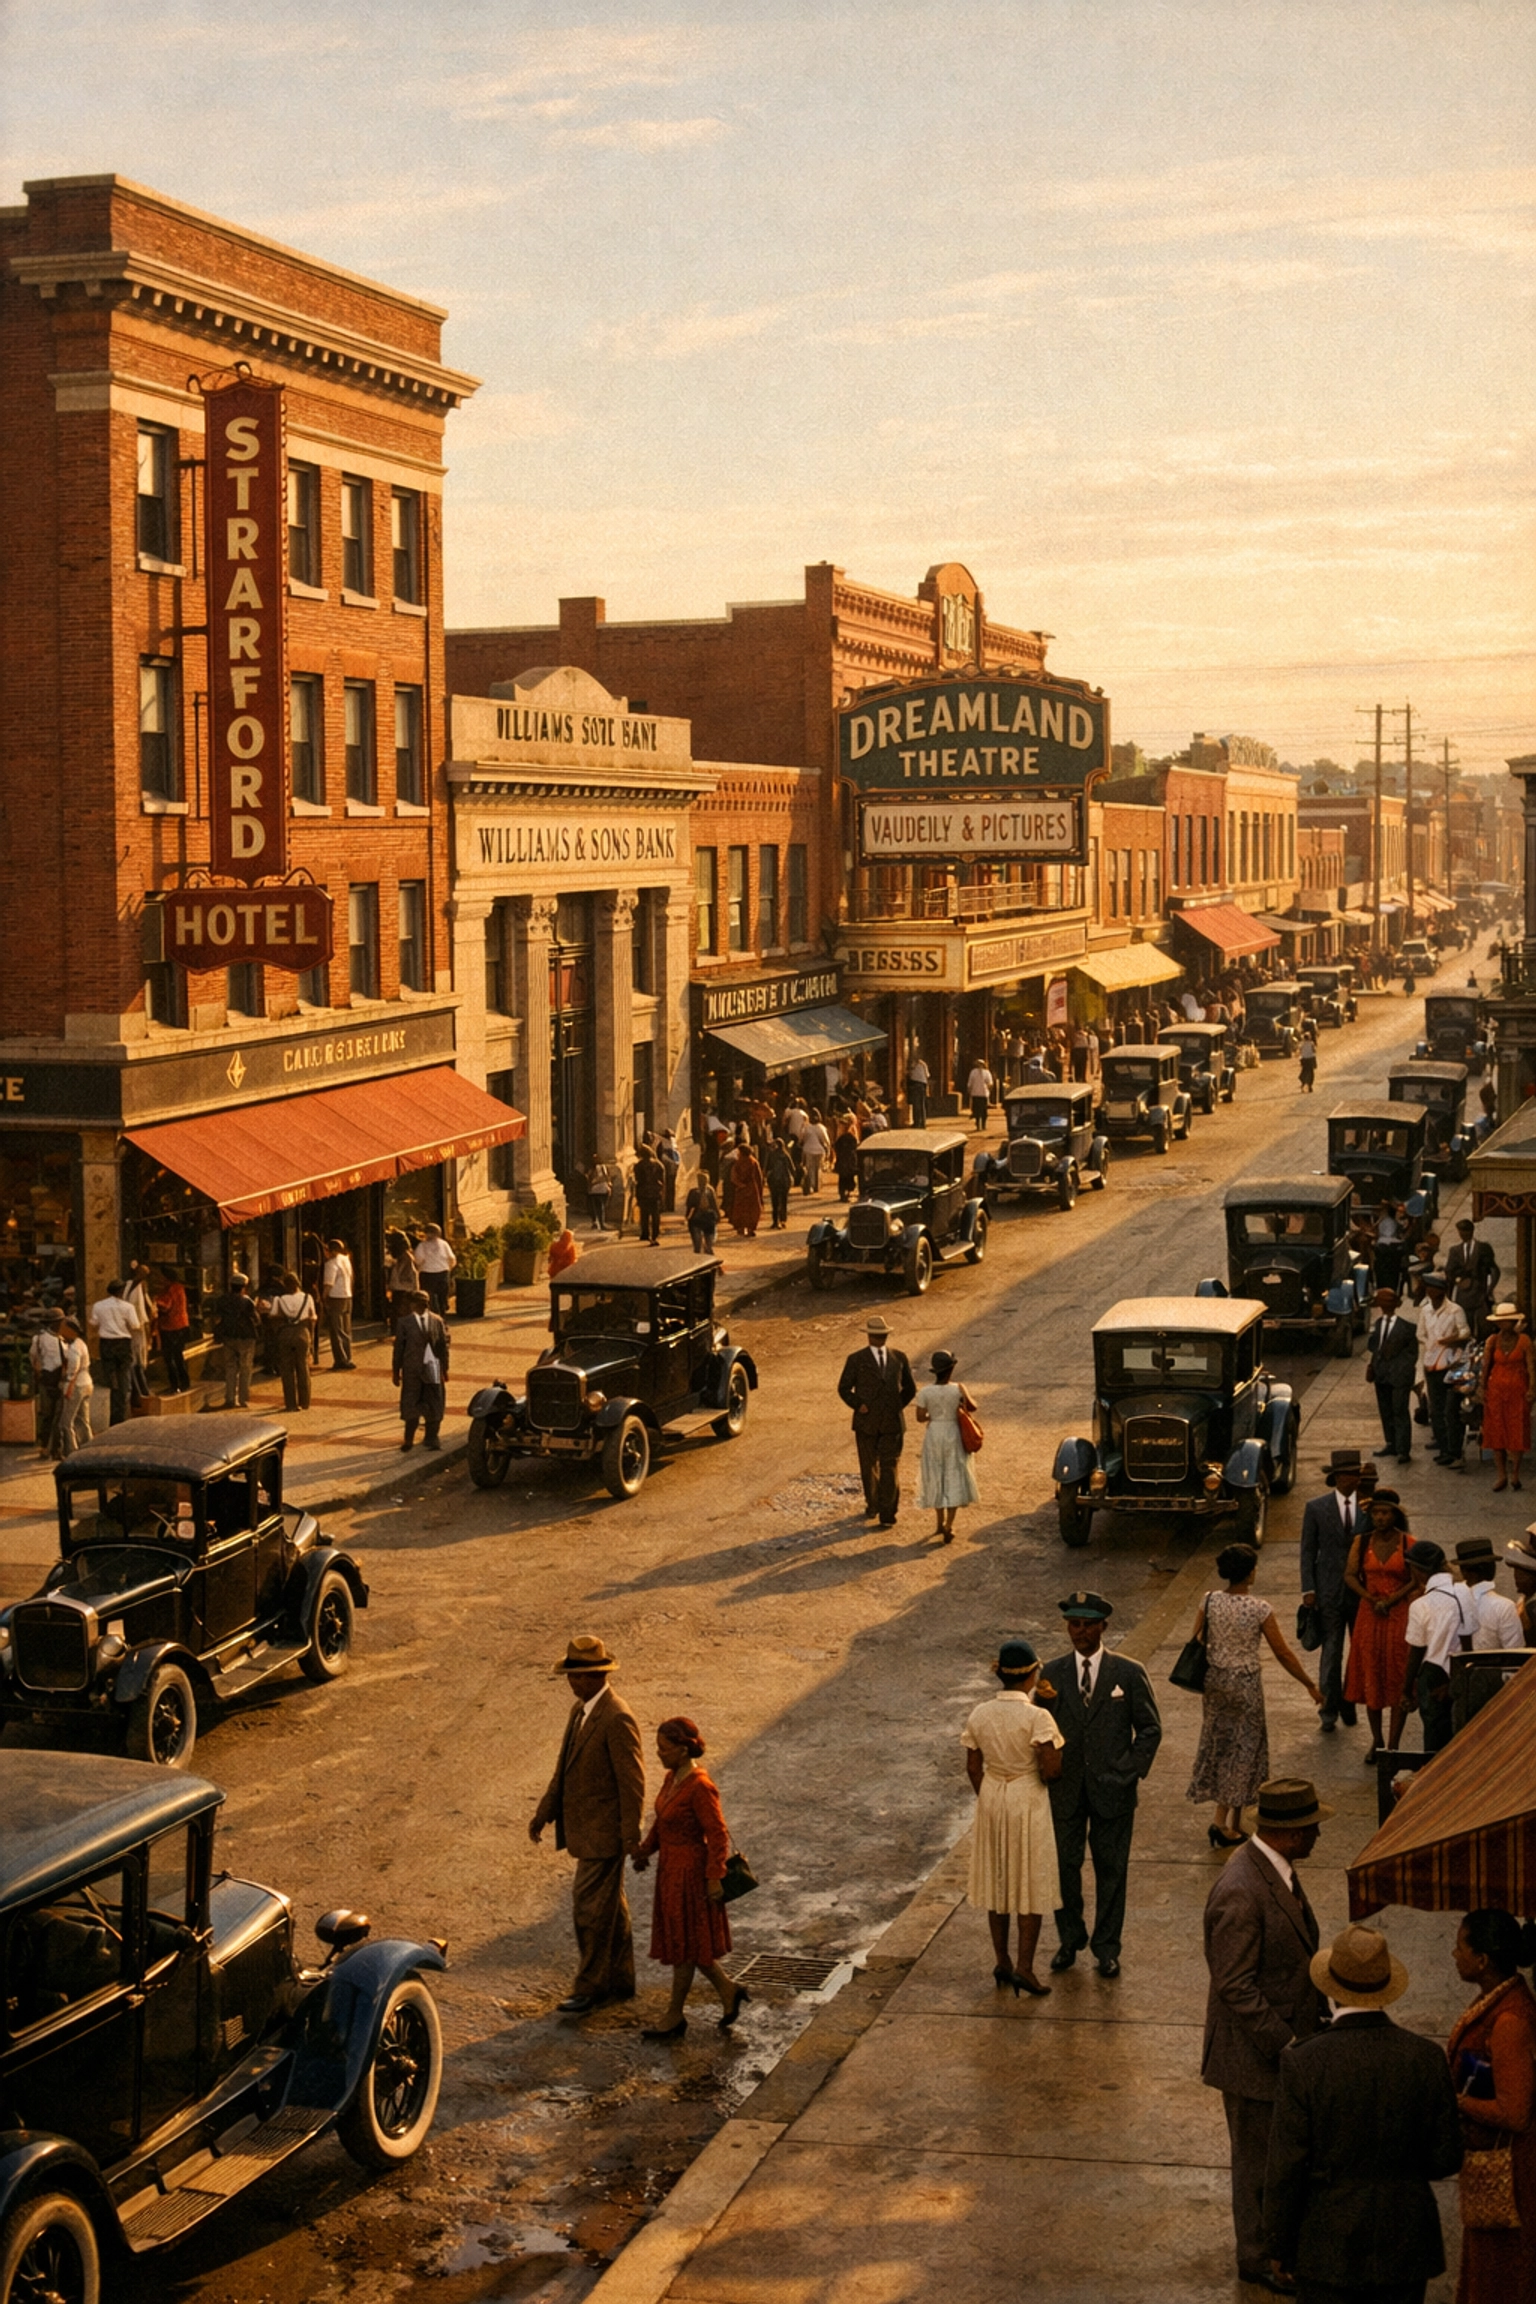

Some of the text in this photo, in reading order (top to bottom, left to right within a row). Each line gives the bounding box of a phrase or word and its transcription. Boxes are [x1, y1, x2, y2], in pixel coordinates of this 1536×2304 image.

[224, 416, 266, 859] STRARFORD
[850, 691, 1094, 760] DREAMLAND
[898, 746, 1040, 778] THEATRE
[477, 826, 676, 864] WILLIAMS & SONS BANK
[962, 815, 975, 842] &
[981, 812, 1067, 842] PICTURES
[175, 902, 318, 946] HOTEL
[0, 1076, 25, 1102] E
